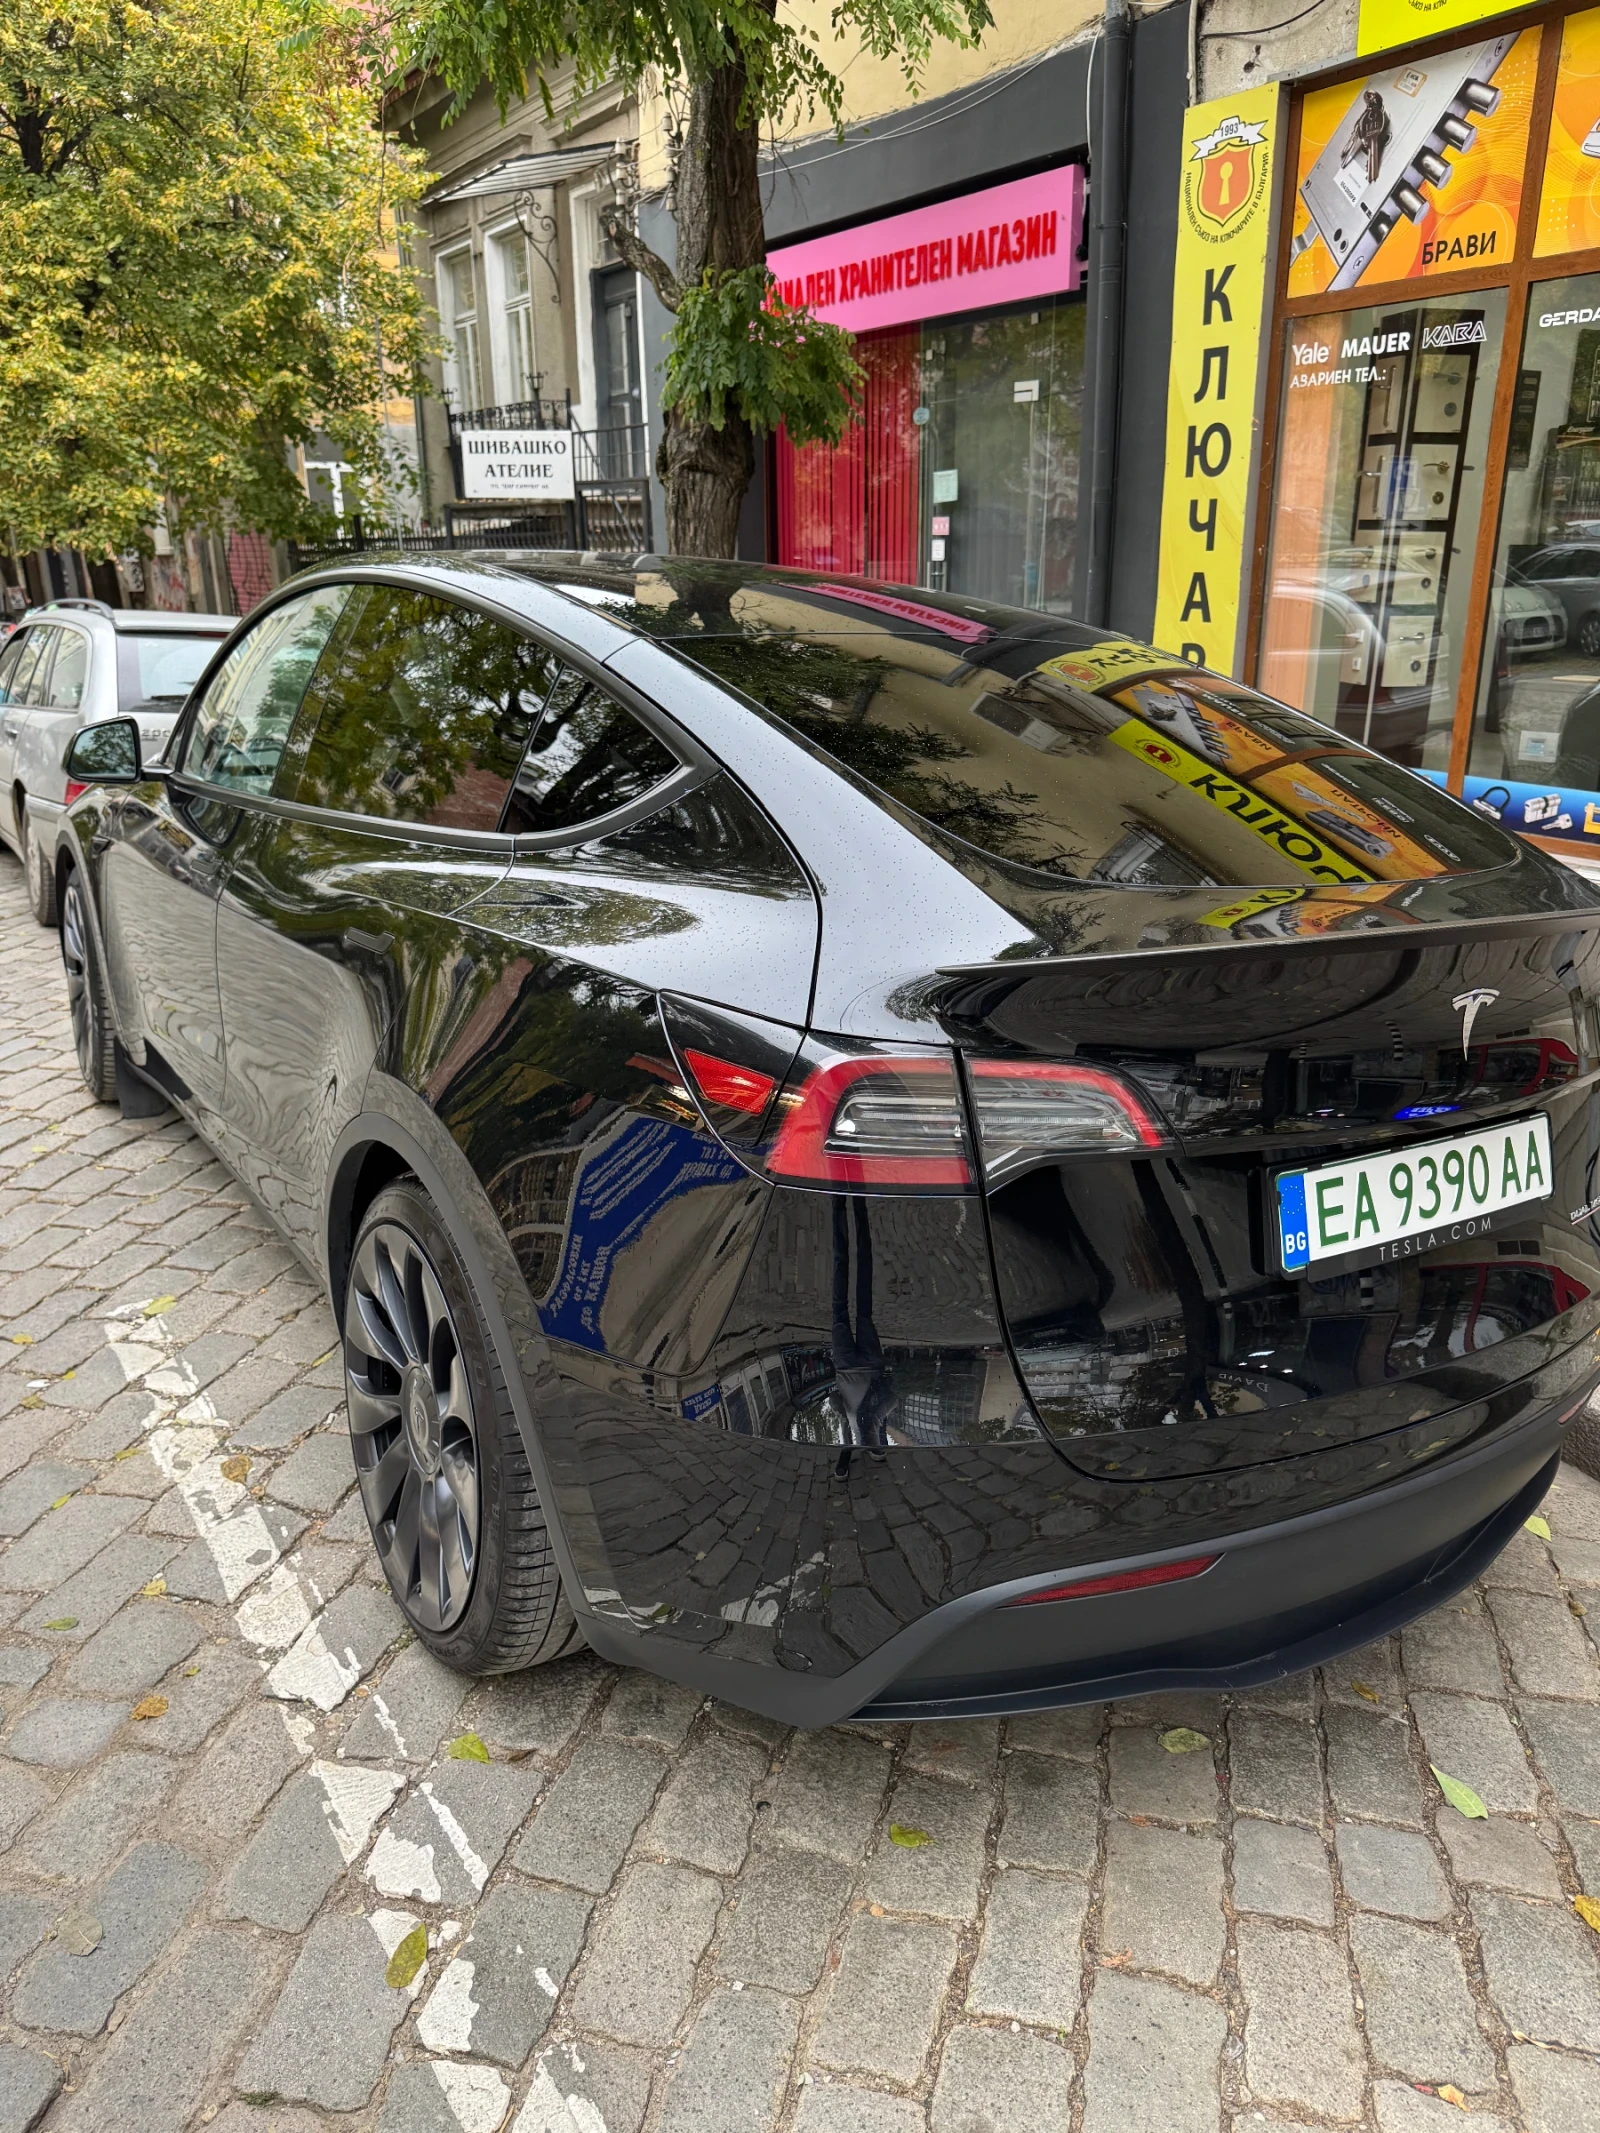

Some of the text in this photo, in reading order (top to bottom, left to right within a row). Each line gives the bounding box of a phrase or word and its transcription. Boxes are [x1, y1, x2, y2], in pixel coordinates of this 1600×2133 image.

[1220, 122, 1239, 138] 1993
[838, 237, 953, 303] ХРАНИТЕЛЕН
[956, 209, 1058, 277] МАГАЗИН
[1421, 230, 1497, 265] БРАВИ
[1291, 342, 1331, 367] Yale
[1341, 331, 1411, 359] MAUER
[467, 440, 567, 455] ШИВАШКО
[484, 463, 554, 478] АТЕЛИЕ
[1285, 1129, 1545, 1254] BG EA 9390 AA
[1379, 1216, 1493, 1262] TESLA.COM
